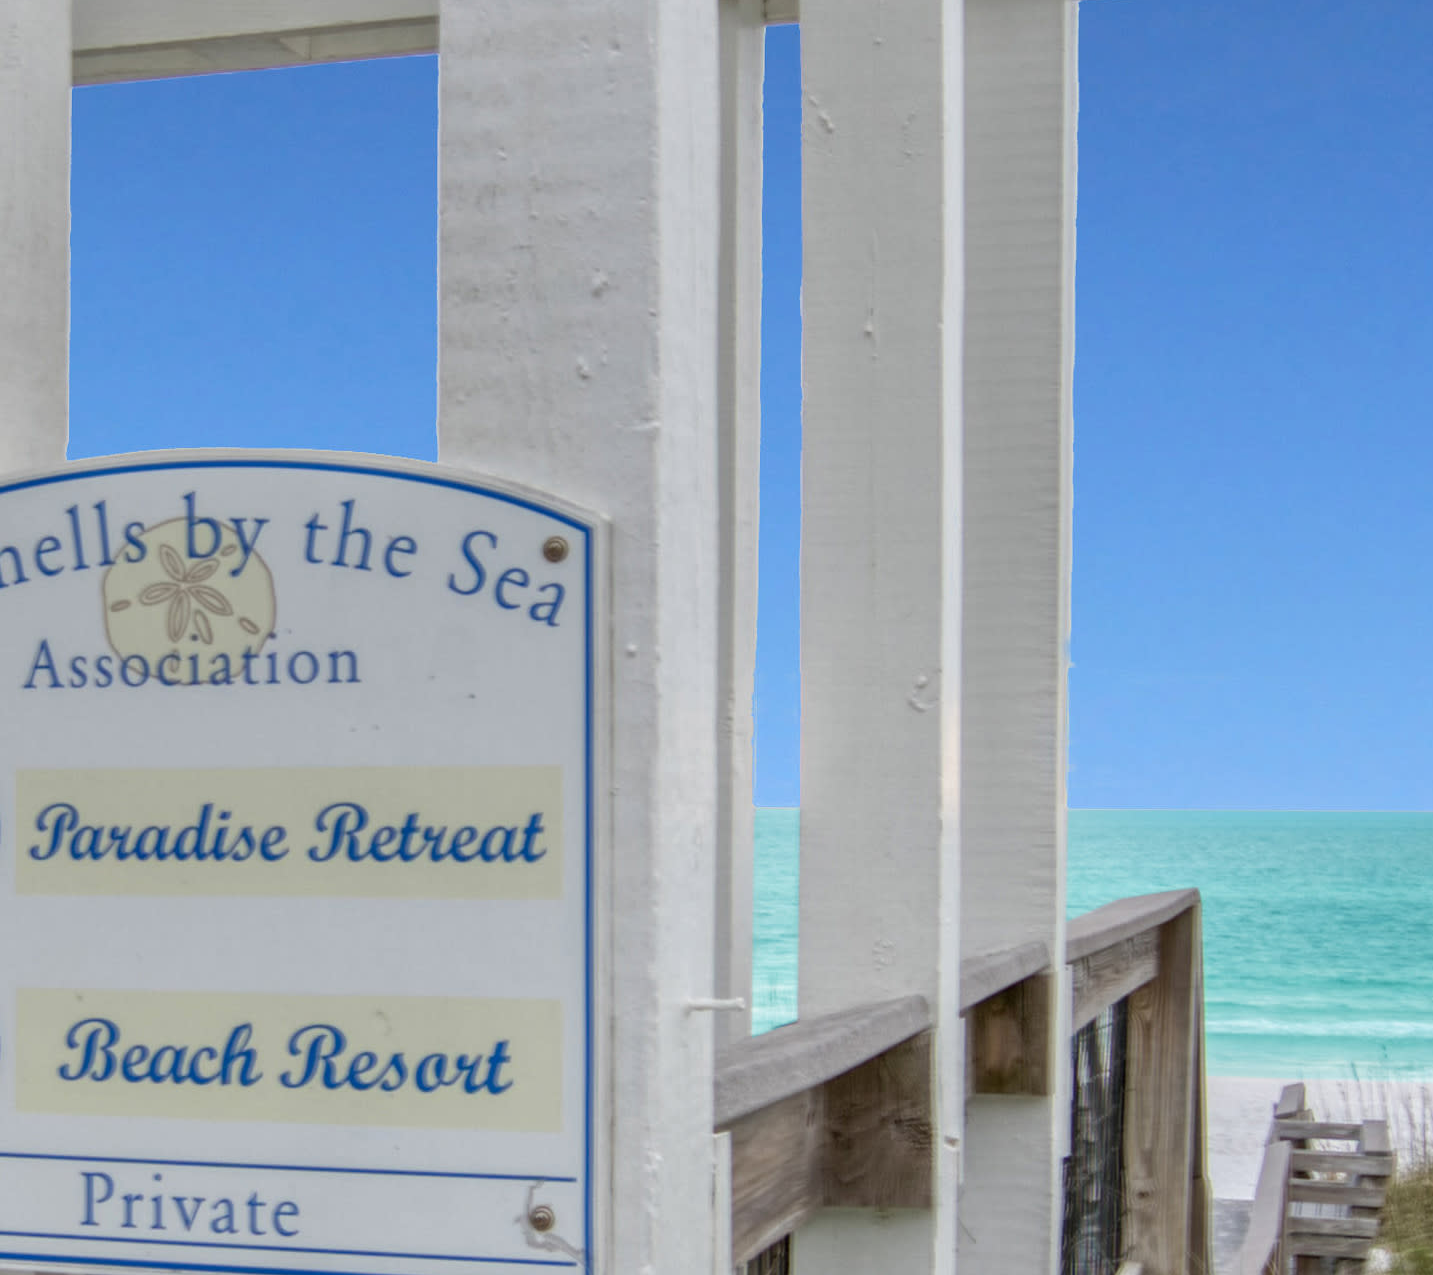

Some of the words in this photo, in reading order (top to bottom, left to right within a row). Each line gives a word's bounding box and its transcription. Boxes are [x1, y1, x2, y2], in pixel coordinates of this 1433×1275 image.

[182, 490, 271, 578] by
[303, 498, 419, 579] the
[447, 529, 567, 627] Sea
[23, 631, 362, 689] Association
[28, 802, 291, 863] Paradise
[307, 801, 549, 864] Retreat
[57, 1017, 263, 1087] Beach
[279, 1023, 514, 1096] Resort
[79, 1171, 301, 1238] Private
